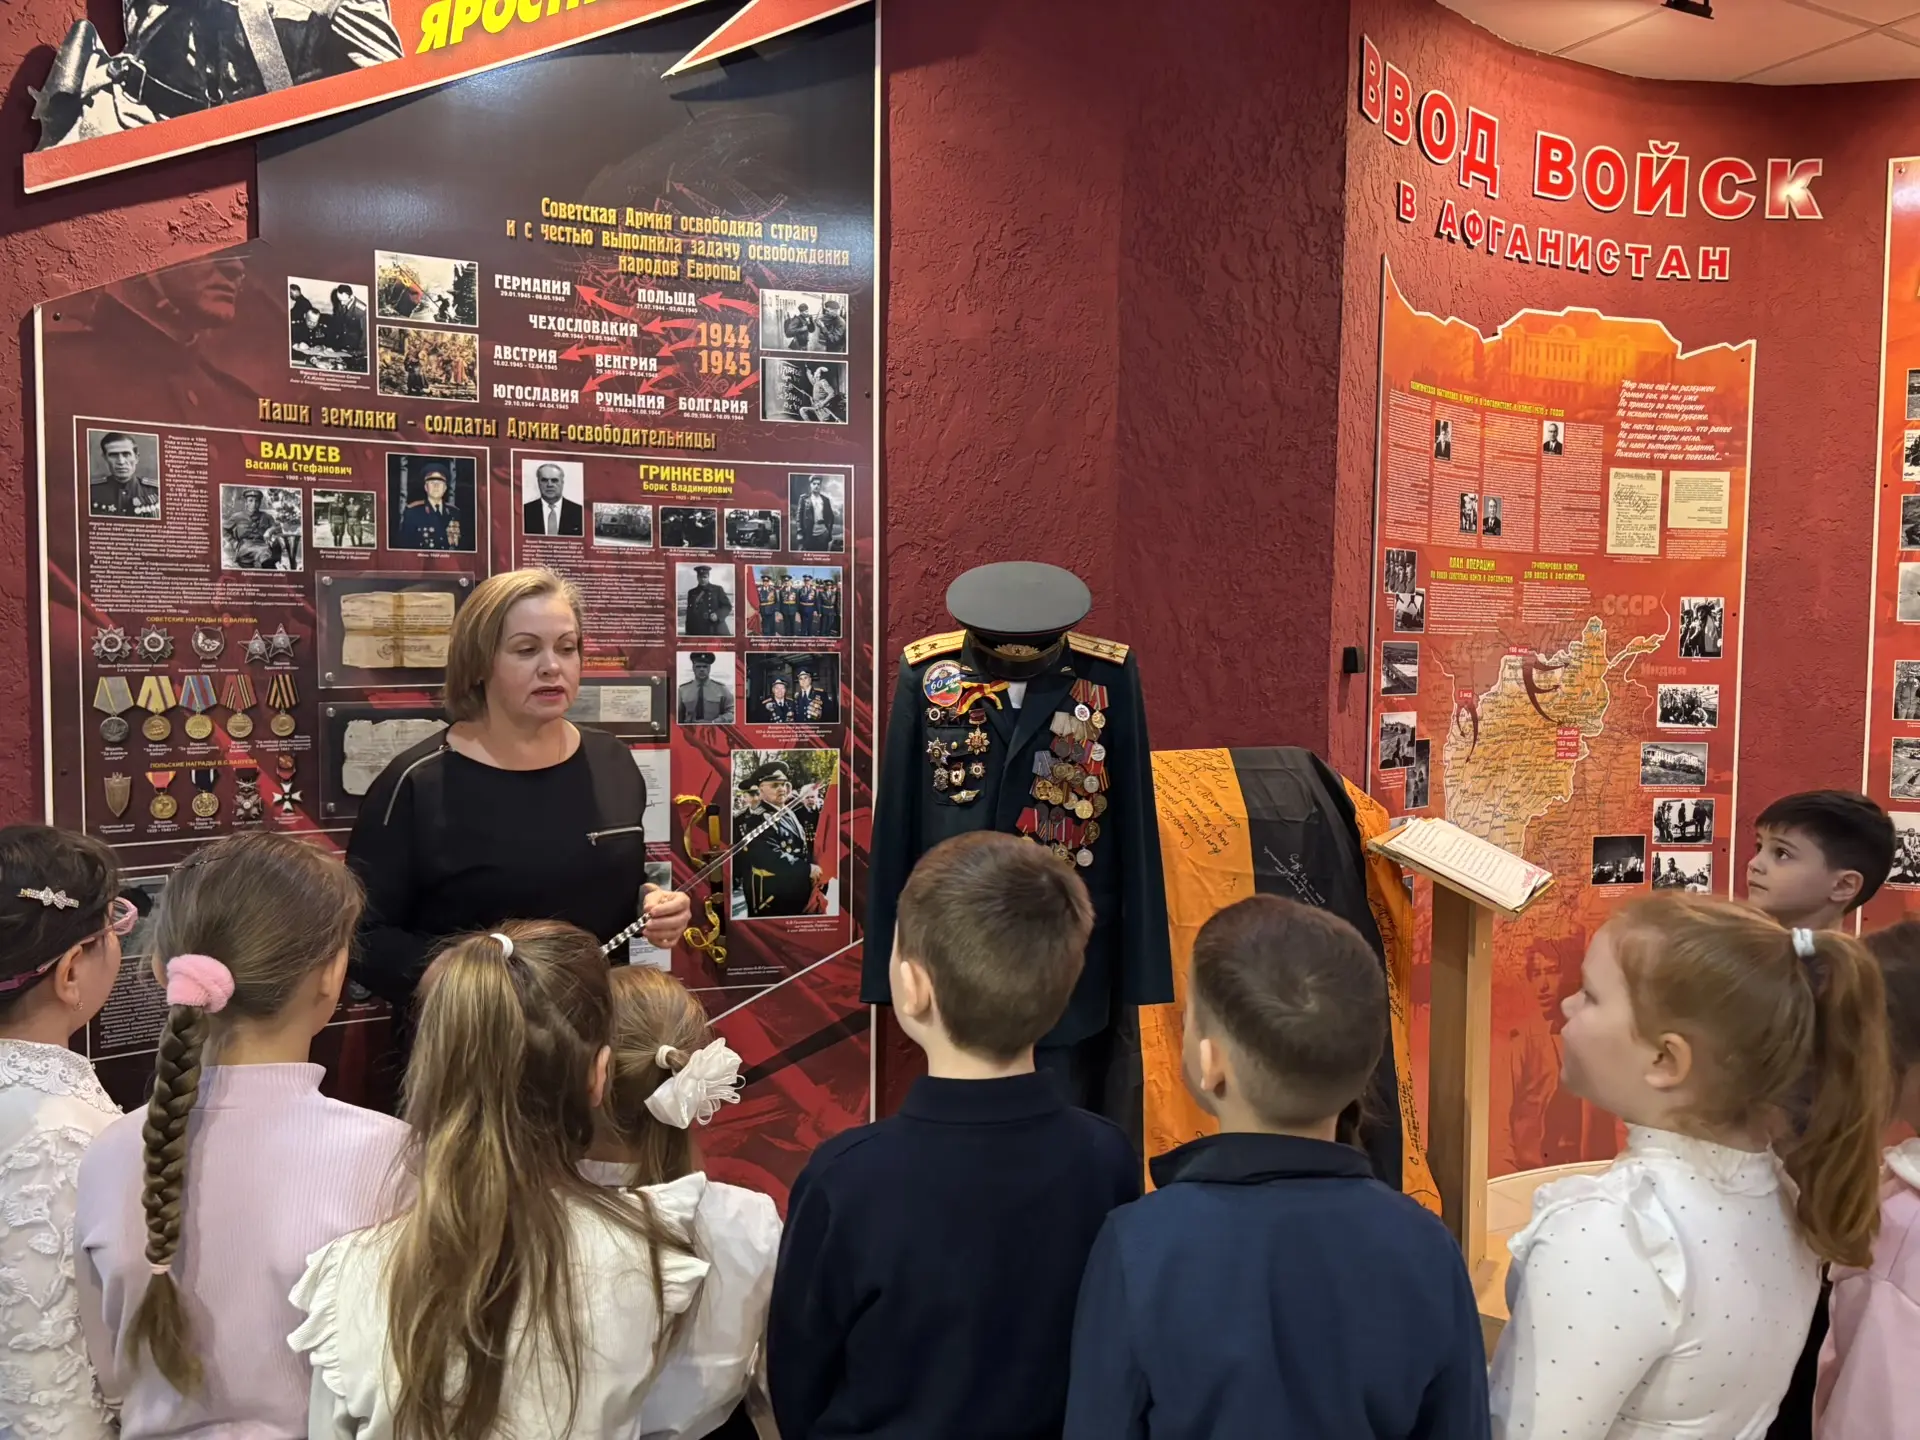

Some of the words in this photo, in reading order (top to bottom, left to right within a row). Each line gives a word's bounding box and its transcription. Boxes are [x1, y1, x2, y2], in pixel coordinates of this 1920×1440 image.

[1362, 33, 1500, 199] ВВОД
[1534, 130, 1824, 220] ВОЙСК
[541, 197, 616, 225] Советская
[625, 207, 672, 231] Армия
[680, 216, 762, 238] освободила
[770, 224, 818, 243] страну
[1400, 180, 1417, 222] В
[1440, 200, 1730, 280] АФГАНИСТАН
[506, 219, 516, 237] и
[524, 222, 532, 238] с
[540, 223, 593, 246] честью
[602, 230, 682, 254] выполнила
[692, 240, 740, 260] задачу
[748, 244, 848, 266] освобождения
[618, 255, 679, 276] народов
[687, 259, 740, 282] Европы
[494, 274, 570, 295] ГЕРМАНИЯ
[638, 288, 696, 306] ПОЛЬША
[529, 314, 638, 337] ЧЕХОСЛОВАКИЯ
[698, 322, 750, 348] 1944
[494, 345, 557, 363] АВСТРИЯ
[595, 354, 658, 372] ВЕНГРИЯ
[699, 350, 750, 376] 1945
[493, 384, 579, 404] ЮГОСЛАВИЯ
[596, 392, 664, 410] РУМЫНИЯ
[679, 396, 748, 414] БОЛГАРИЯ
[258, 398, 310, 424] Наши
[321, 407, 397, 430] земляки
[424, 414, 497, 437] солдаты
[507, 418, 717, 450] Армии-освободительницы
[260, 442, 341, 462] ВАЛУЕВ
[245, 458, 288, 472] Василий
[292, 461, 352, 476] Стефанович
[640, 464, 734, 484] ГРИНКЕВИЧ
[643, 481, 668, 492] Борис
[671, 482, 732, 494] Владимирович
[1602, 594, 1658, 616] СССР
[1640, 662, 1687, 676] Индия
[930, 680, 942, 690] 60
